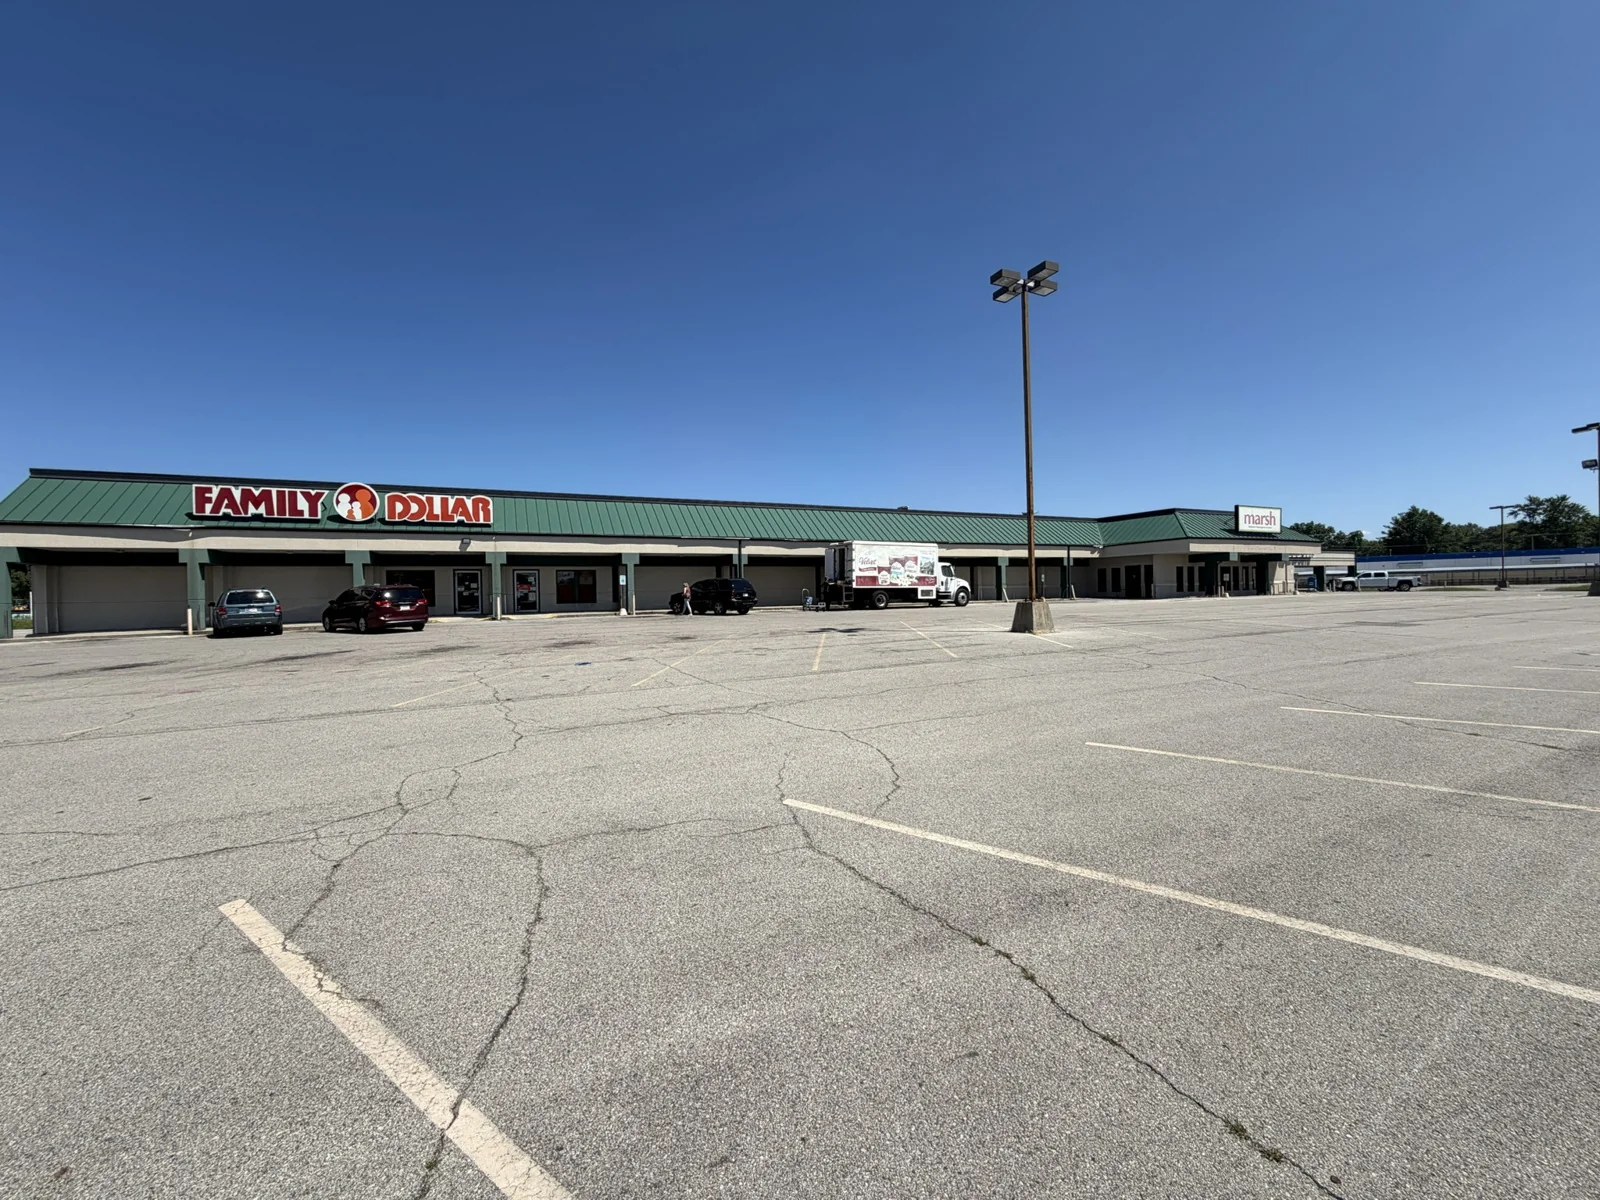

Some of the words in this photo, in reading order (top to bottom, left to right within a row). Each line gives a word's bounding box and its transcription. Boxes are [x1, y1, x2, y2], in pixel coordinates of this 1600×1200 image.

[193, 485, 328, 518] FAMILY
[386, 493, 493, 523] DOLLAR
[1244, 511, 1276, 526] marsh
